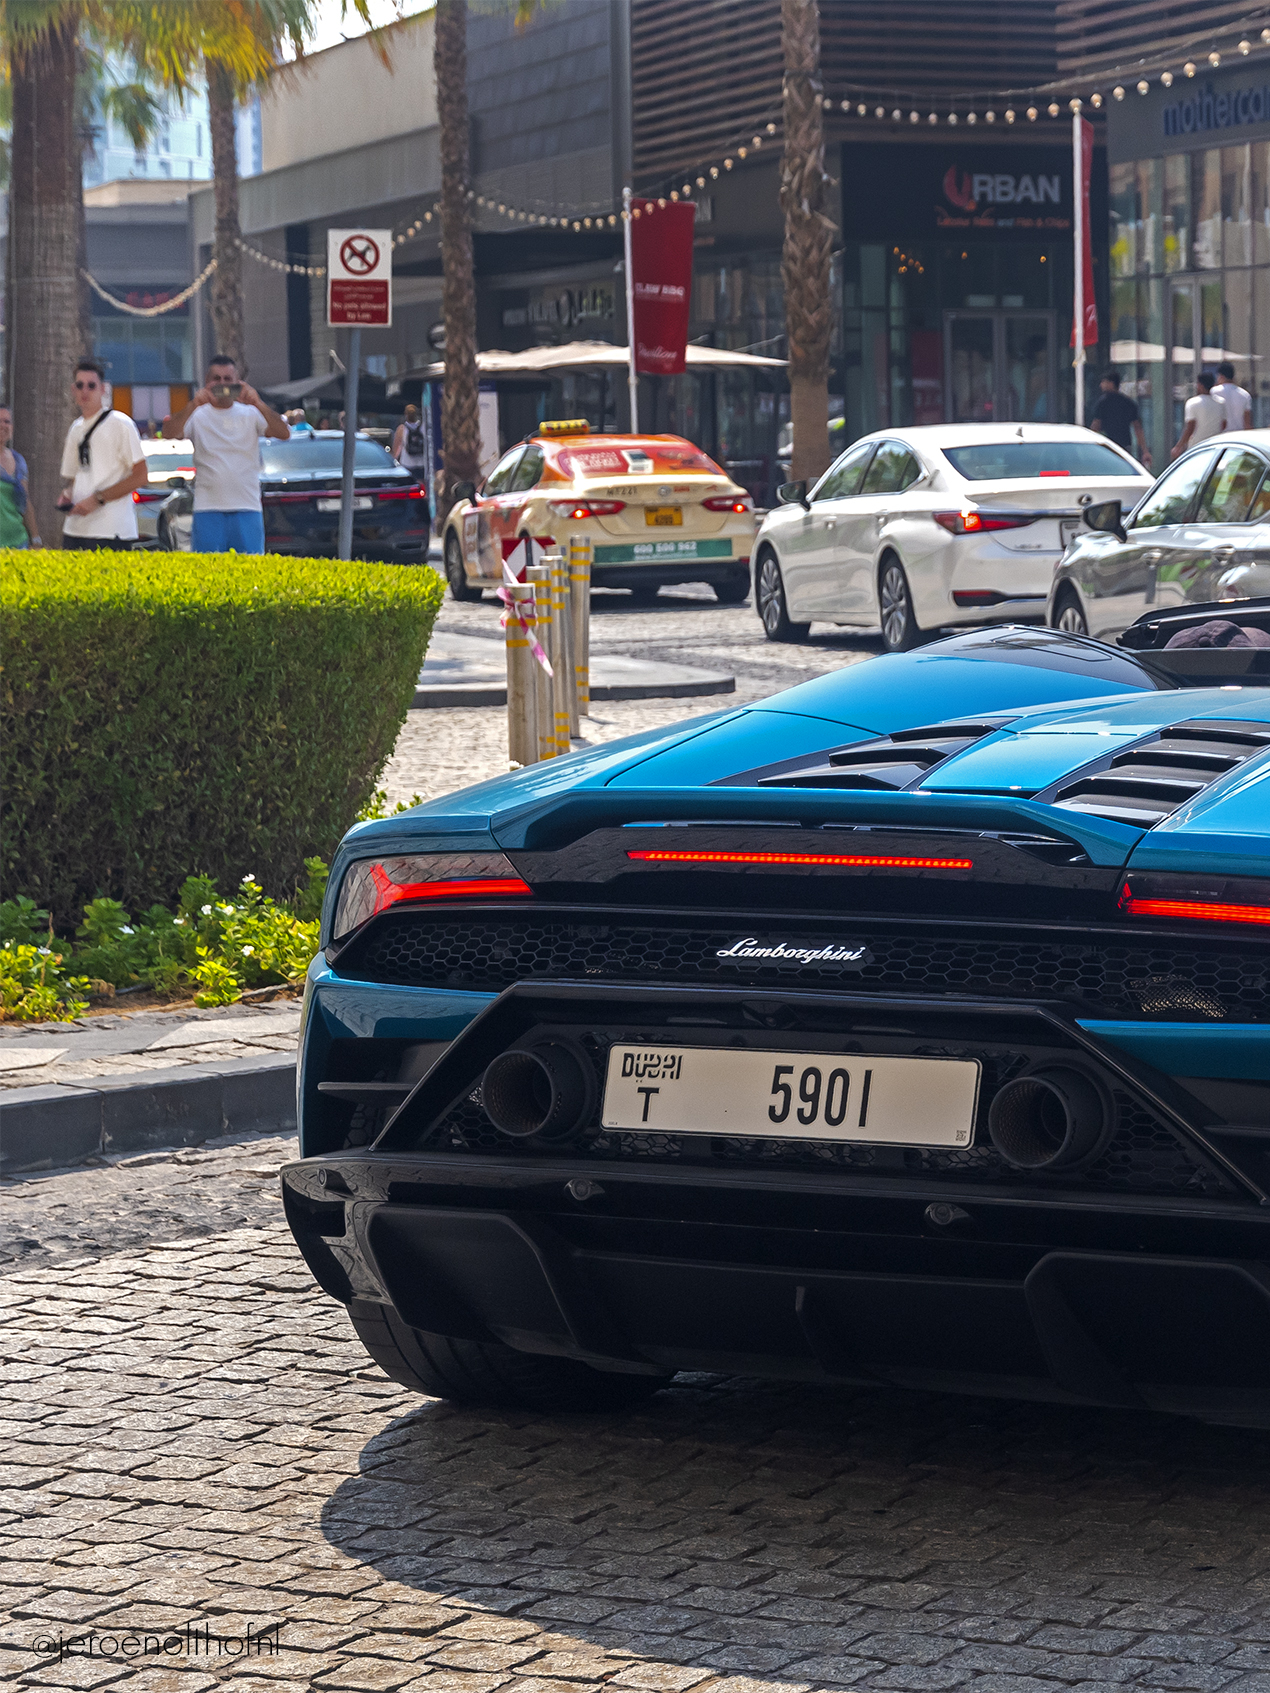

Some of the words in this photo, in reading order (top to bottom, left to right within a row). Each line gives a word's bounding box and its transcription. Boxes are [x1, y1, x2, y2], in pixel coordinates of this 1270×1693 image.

[943, 165, 1061, 211] URBAN
[716, 937, 866, 964] Lamborghini
[637, 1086, 660, 1122] T
[768, 1064, 873, 1128] 5901
